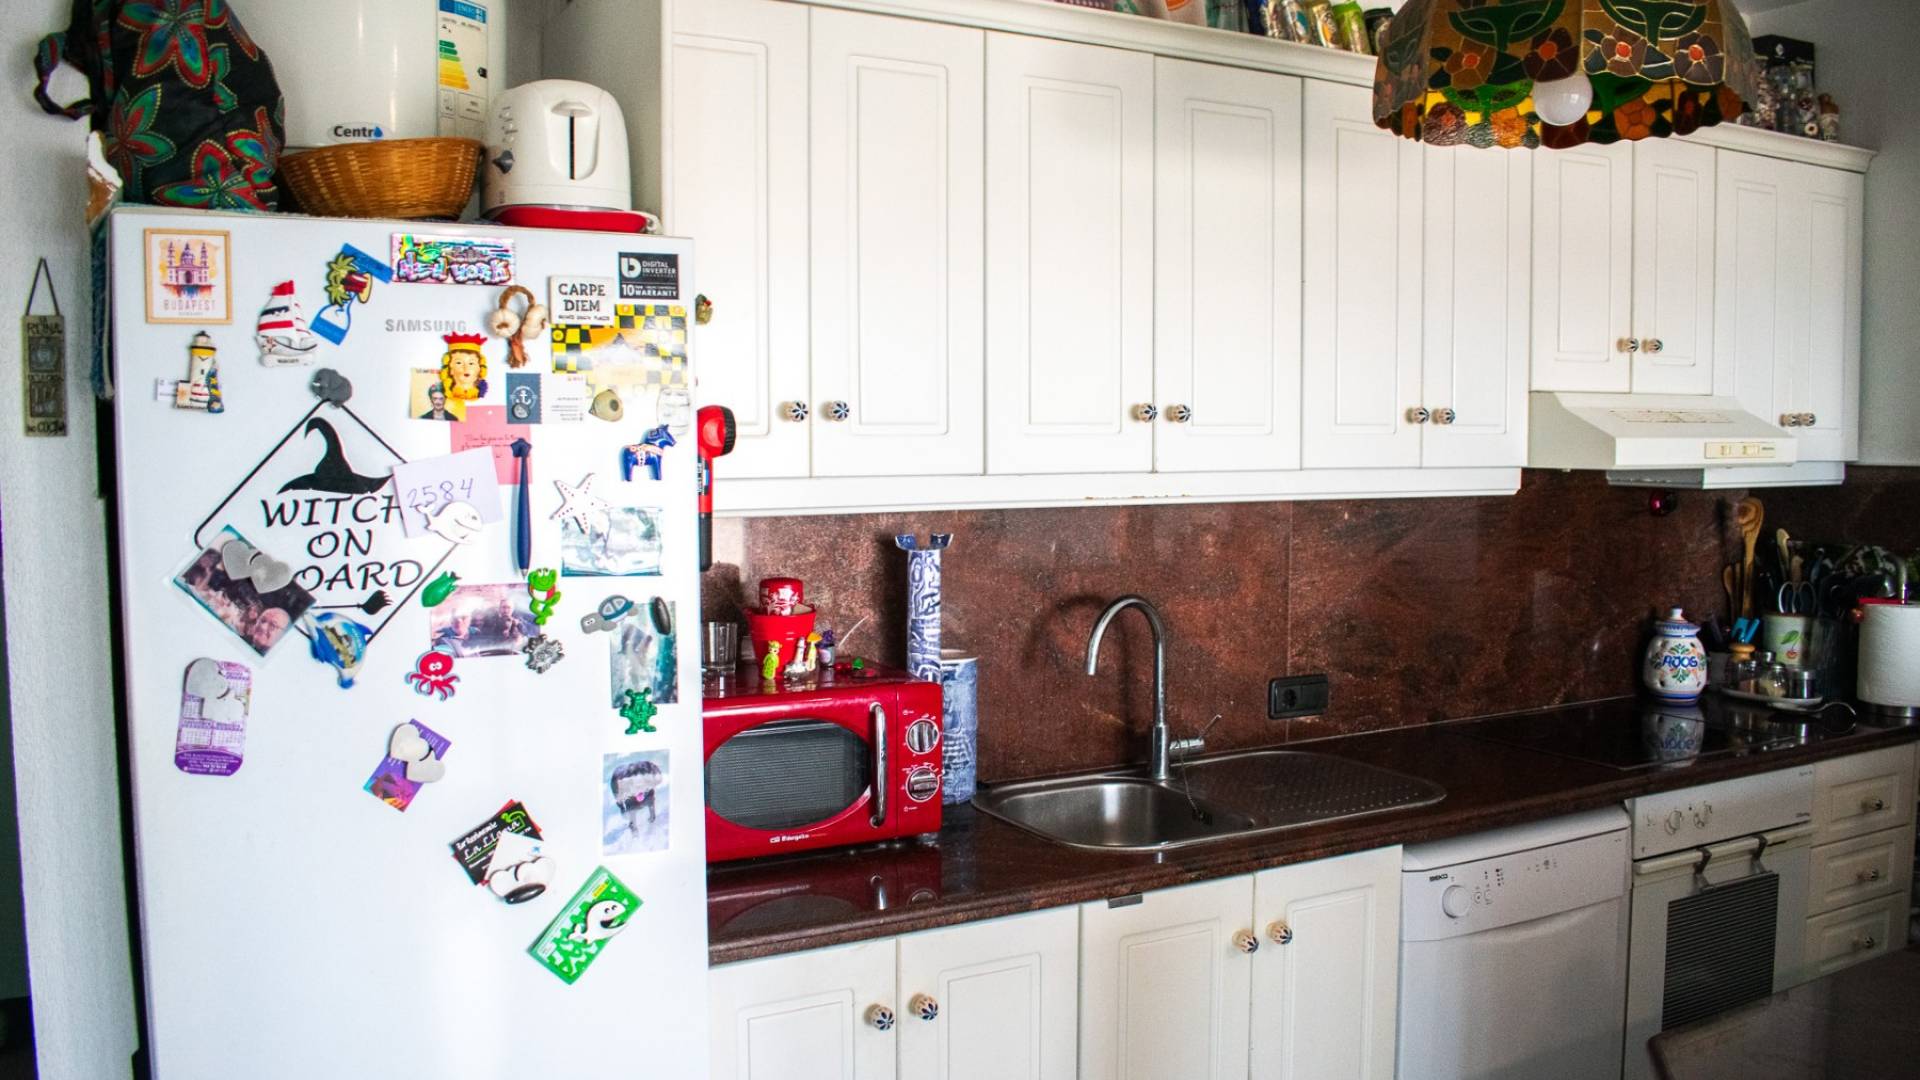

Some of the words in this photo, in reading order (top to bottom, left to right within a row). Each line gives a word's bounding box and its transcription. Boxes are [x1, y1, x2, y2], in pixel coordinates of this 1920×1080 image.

[642, 260, 669, 268] DIGITAL
[642, 267, 677, 275] INVERTER
[558, 283, 606, 296] CARPE
[621, 284, 635, 297] 10
[635, 289, 678, 297] WARRANTY
[563, 299, 601, 312] DIEM
[385, 318, 467, 333] SAMSUNG
[406, 477, 474, 508] 2584
[307, 528, 374, 558] ON
[293, 559, 423, 592] OARD
